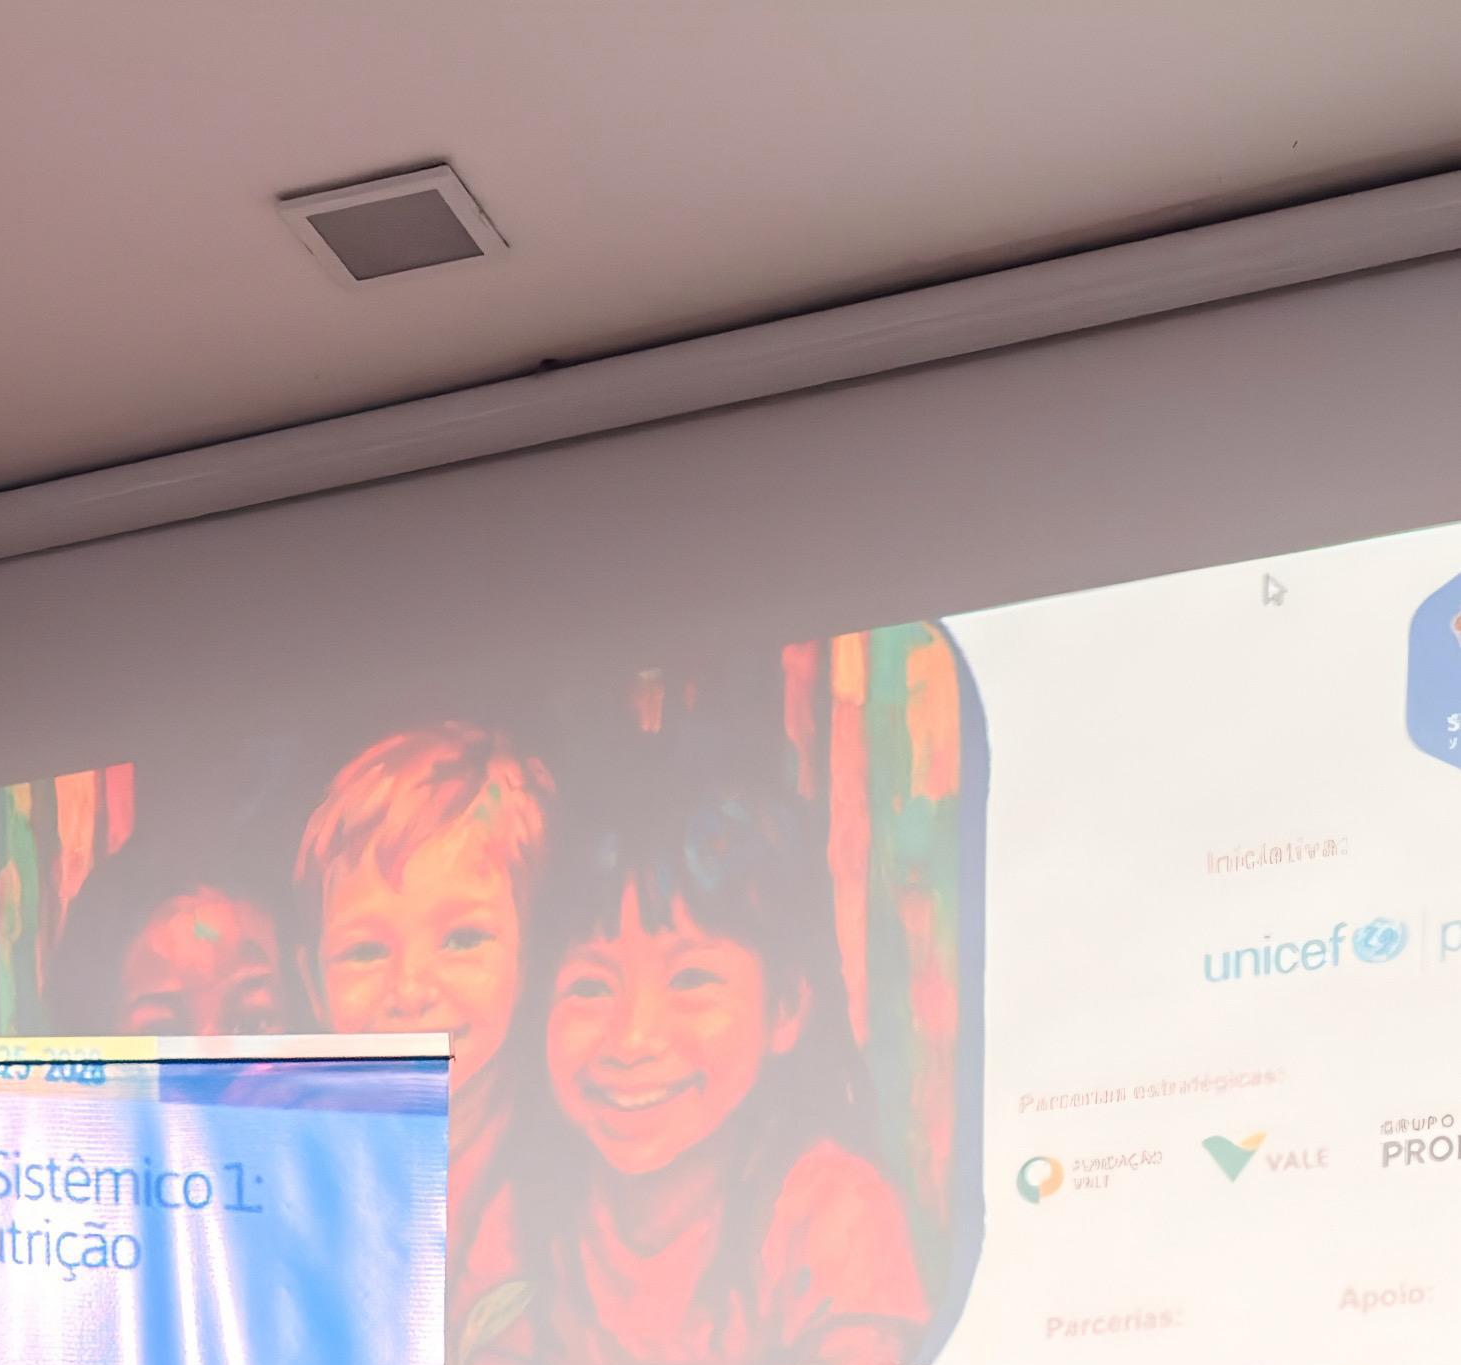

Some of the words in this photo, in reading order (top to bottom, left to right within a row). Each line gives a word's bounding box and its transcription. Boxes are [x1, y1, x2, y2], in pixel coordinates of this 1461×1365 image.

[1204, 922, 1347, 982] unicef
[1265, 1147, 1330, 1171] VALE
[1382, 1134, 1461, 1168] PRO
[223, 1161, 264, 1214] 1:
